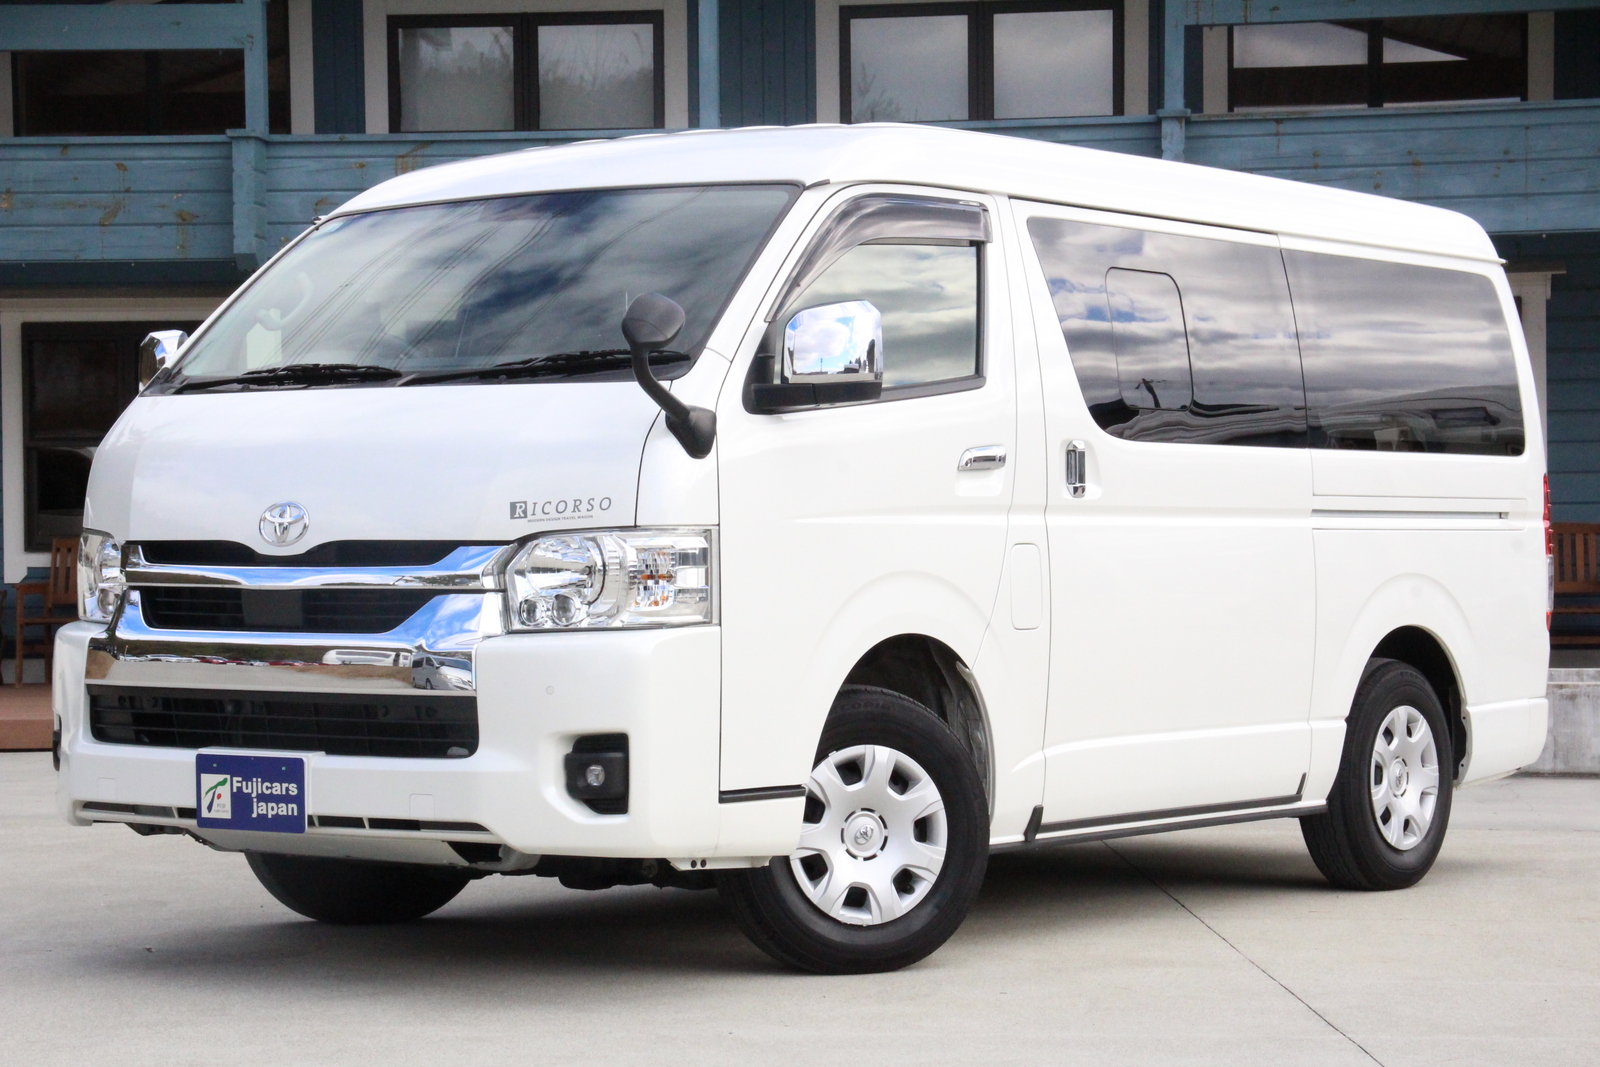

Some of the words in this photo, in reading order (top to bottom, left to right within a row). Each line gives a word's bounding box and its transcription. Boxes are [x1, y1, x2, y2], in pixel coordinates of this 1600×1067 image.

[510, 497, 612, 519] RICORSO
[232, 776, 298, 798] Fujicars
[252, 798, 298, 818] japan
